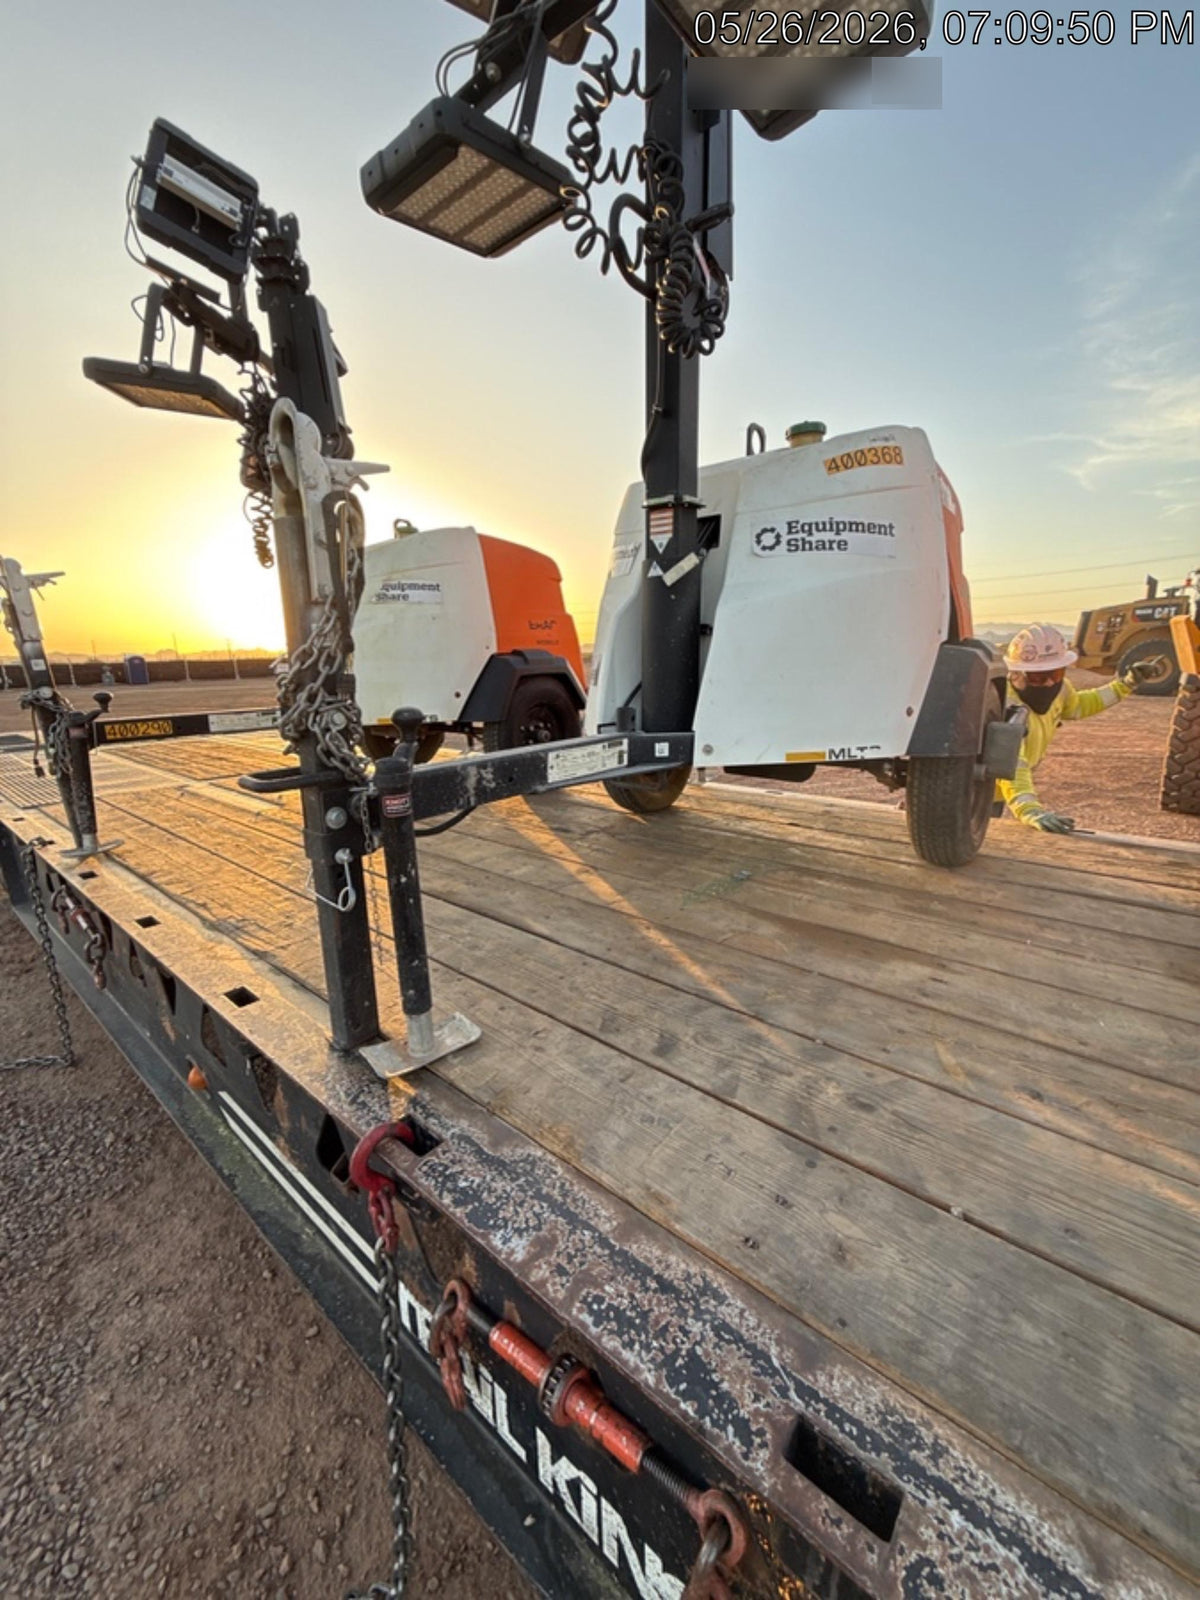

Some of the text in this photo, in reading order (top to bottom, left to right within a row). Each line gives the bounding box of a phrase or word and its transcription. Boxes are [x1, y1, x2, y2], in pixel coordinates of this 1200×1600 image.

[827, 446, 904, 473] 400368
[786, 517, 896, 538] Equipment
[786, 537, 849, 553] Share
[381, 580, 441, 592] quipment
[106, 720, 173, 739] 400290
[828, 745, 881, 760] MLT
